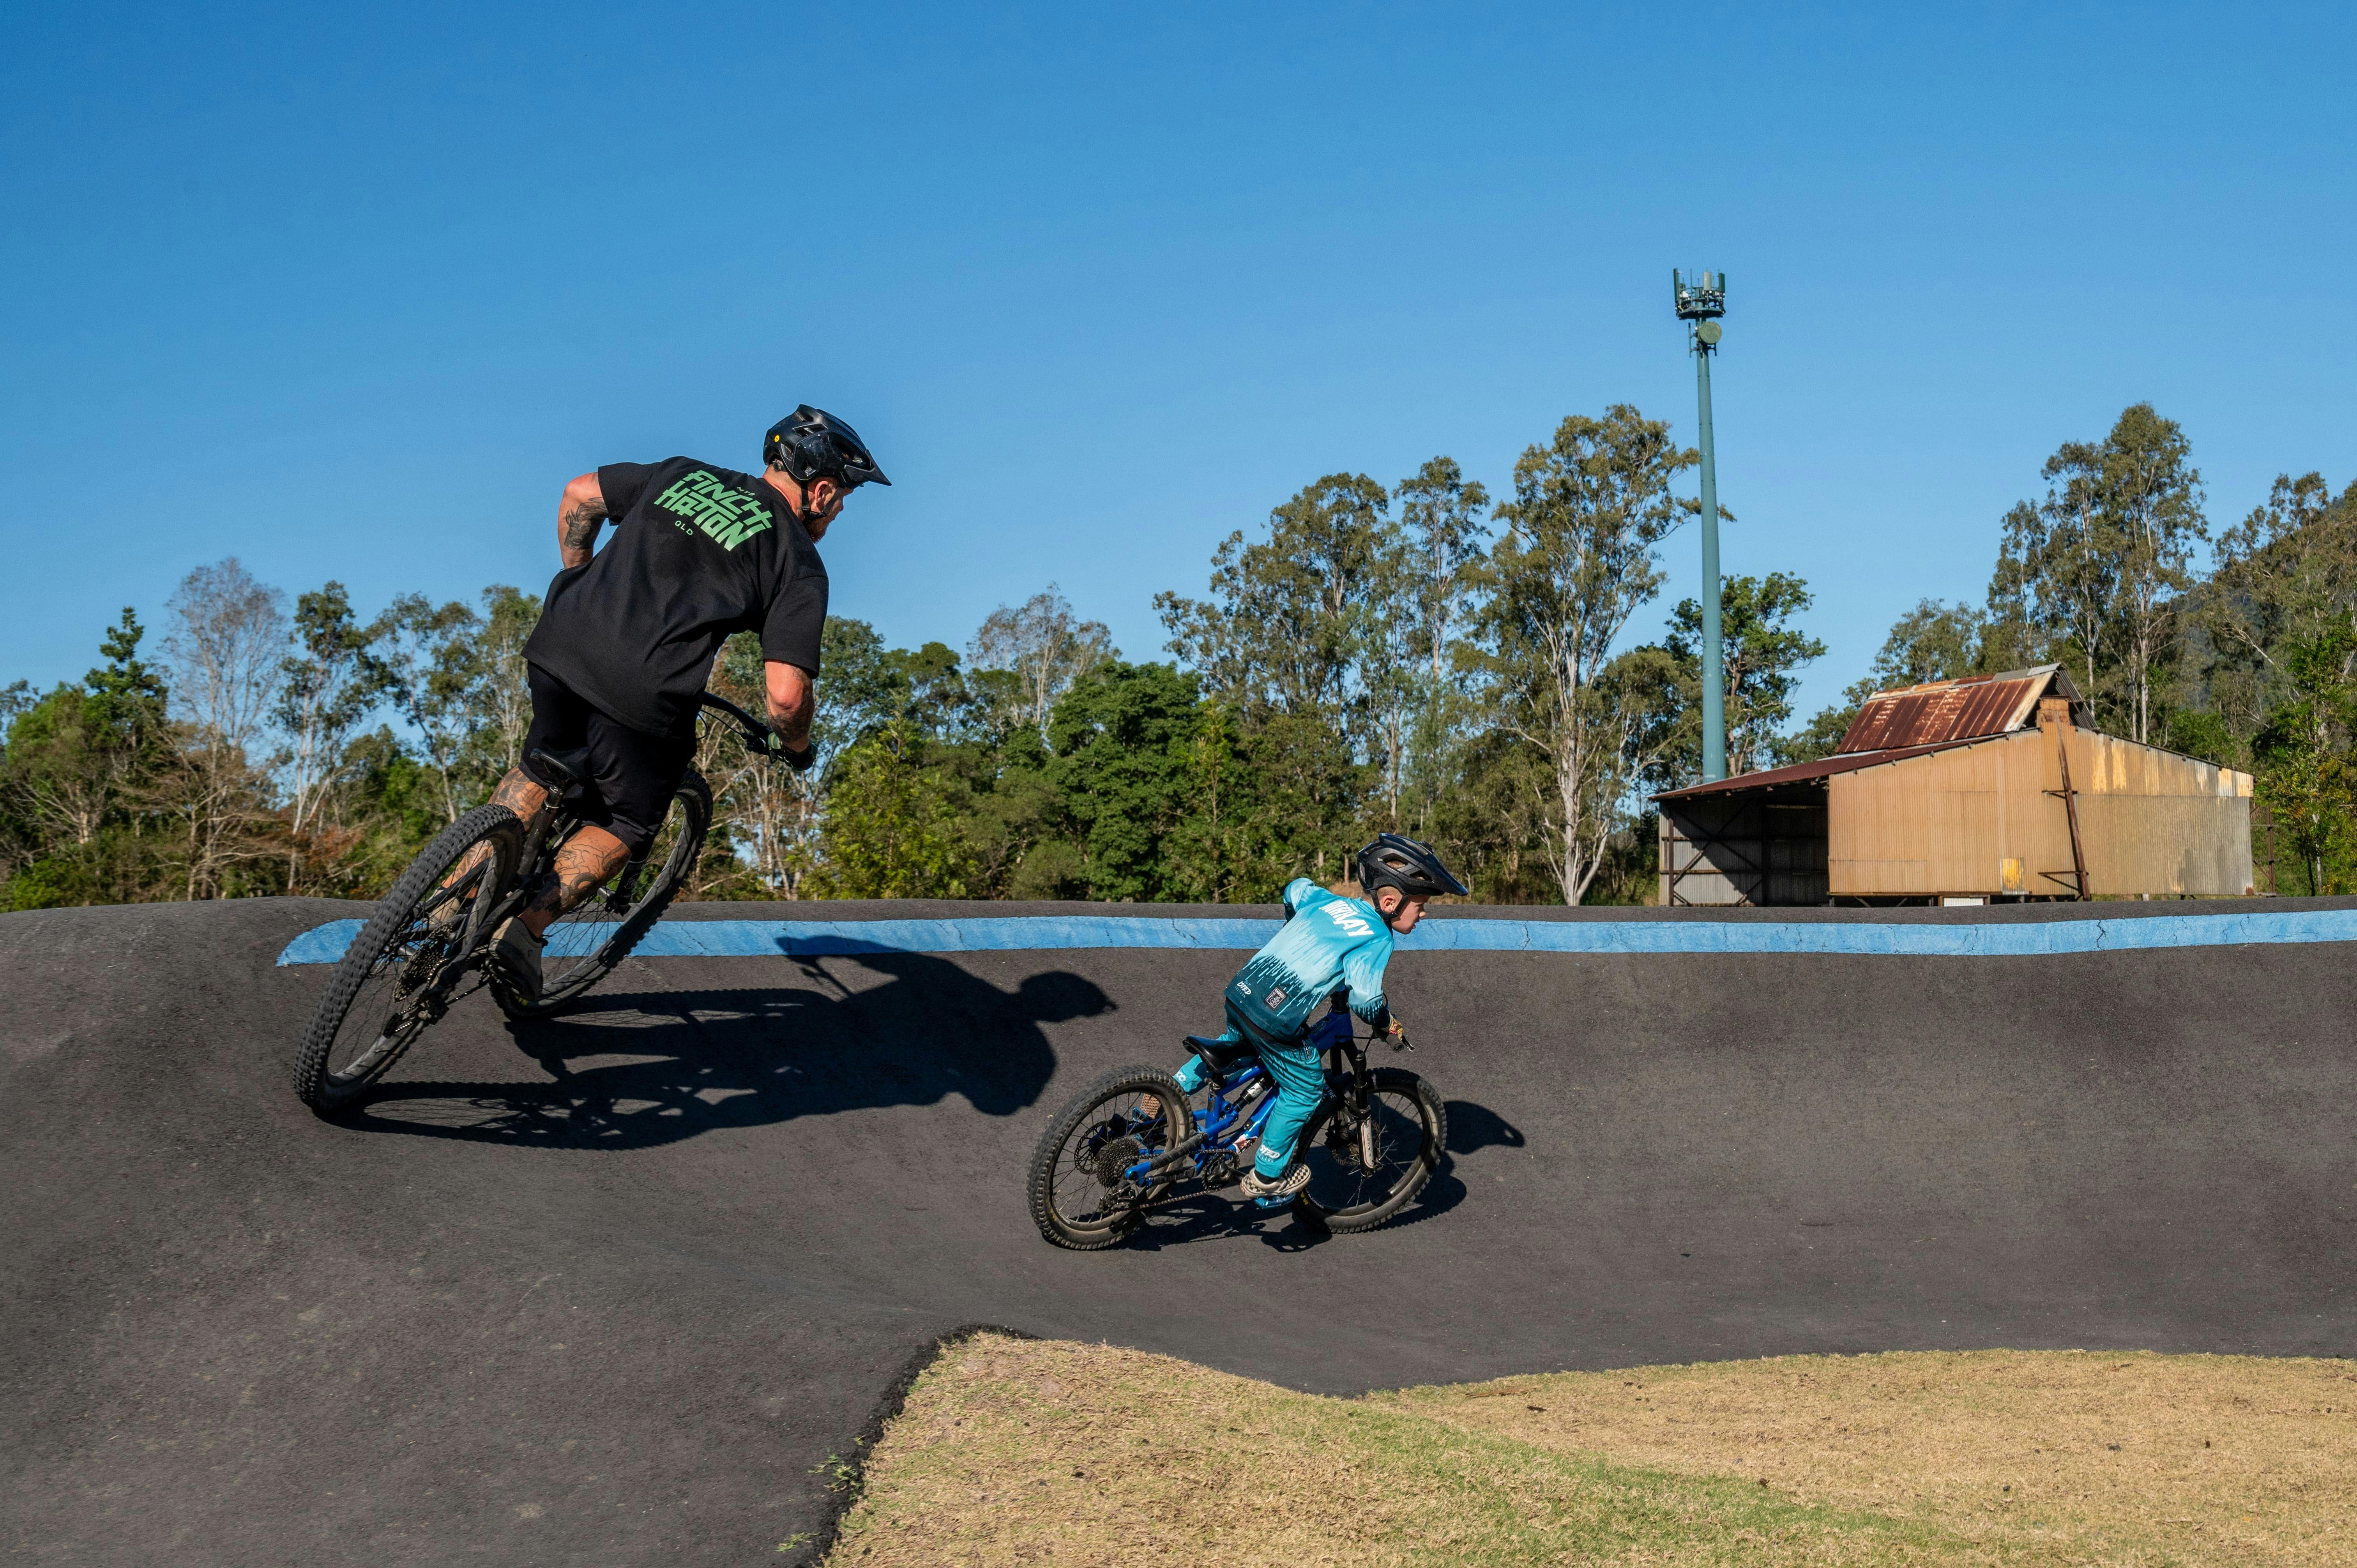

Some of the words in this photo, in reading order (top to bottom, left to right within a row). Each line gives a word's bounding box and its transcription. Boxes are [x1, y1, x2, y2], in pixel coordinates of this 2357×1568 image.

[683, 470, 773, 528] FINCH
[737, 487, 755, 496] MTB
[654, 480, 767, 551] HATTON
[675, 520, 693, 535] QLD
